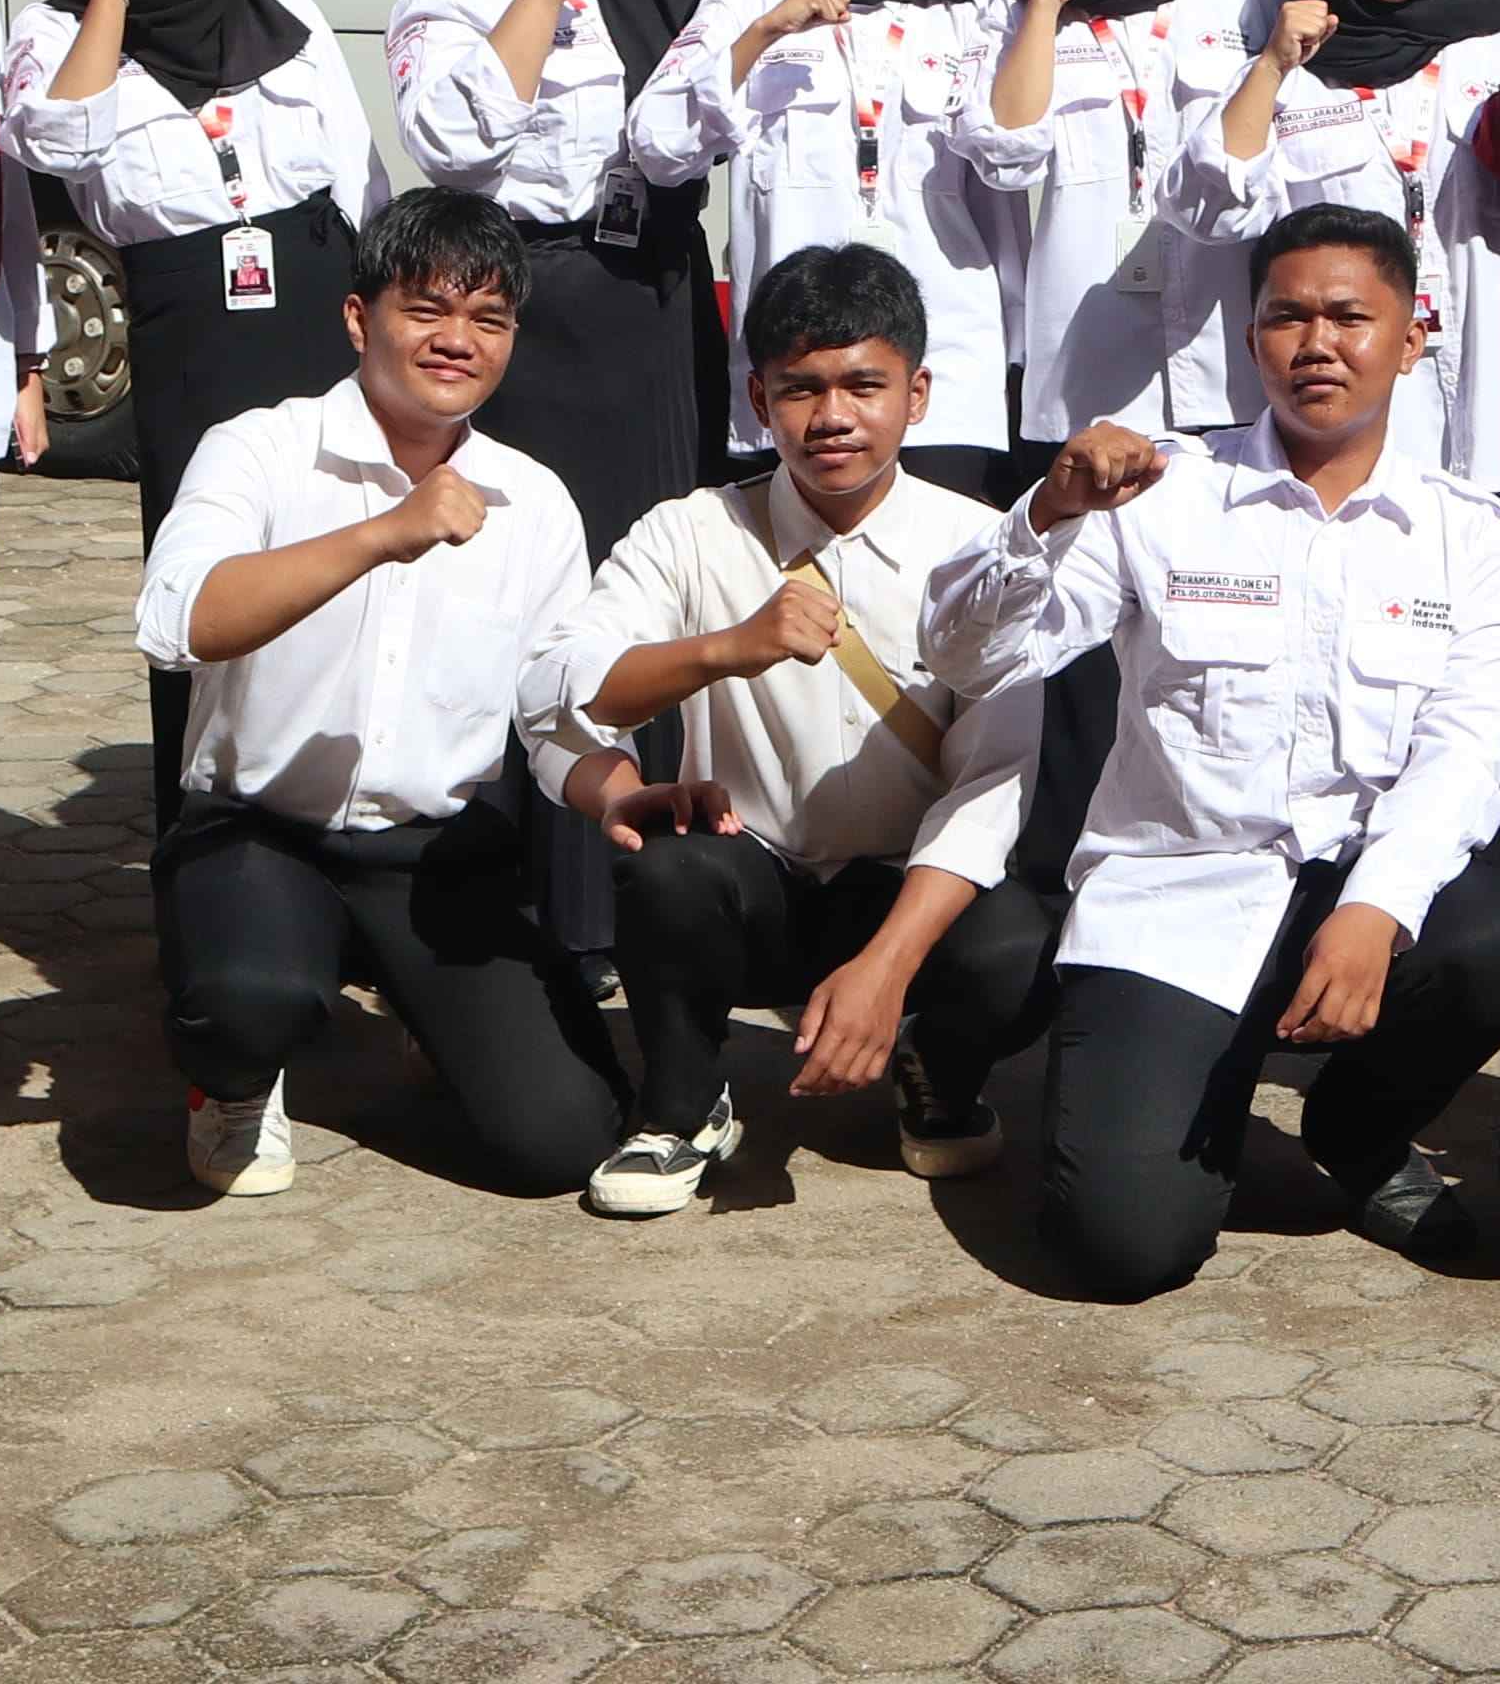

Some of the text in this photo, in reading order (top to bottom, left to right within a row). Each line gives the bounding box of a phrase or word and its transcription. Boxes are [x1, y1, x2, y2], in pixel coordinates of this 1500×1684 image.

[1171, 573, 1230, 587] MUHAMMAD
[1414, 598, 1452, 612] Palang
[1413, 608, 1449, 620] Merah
